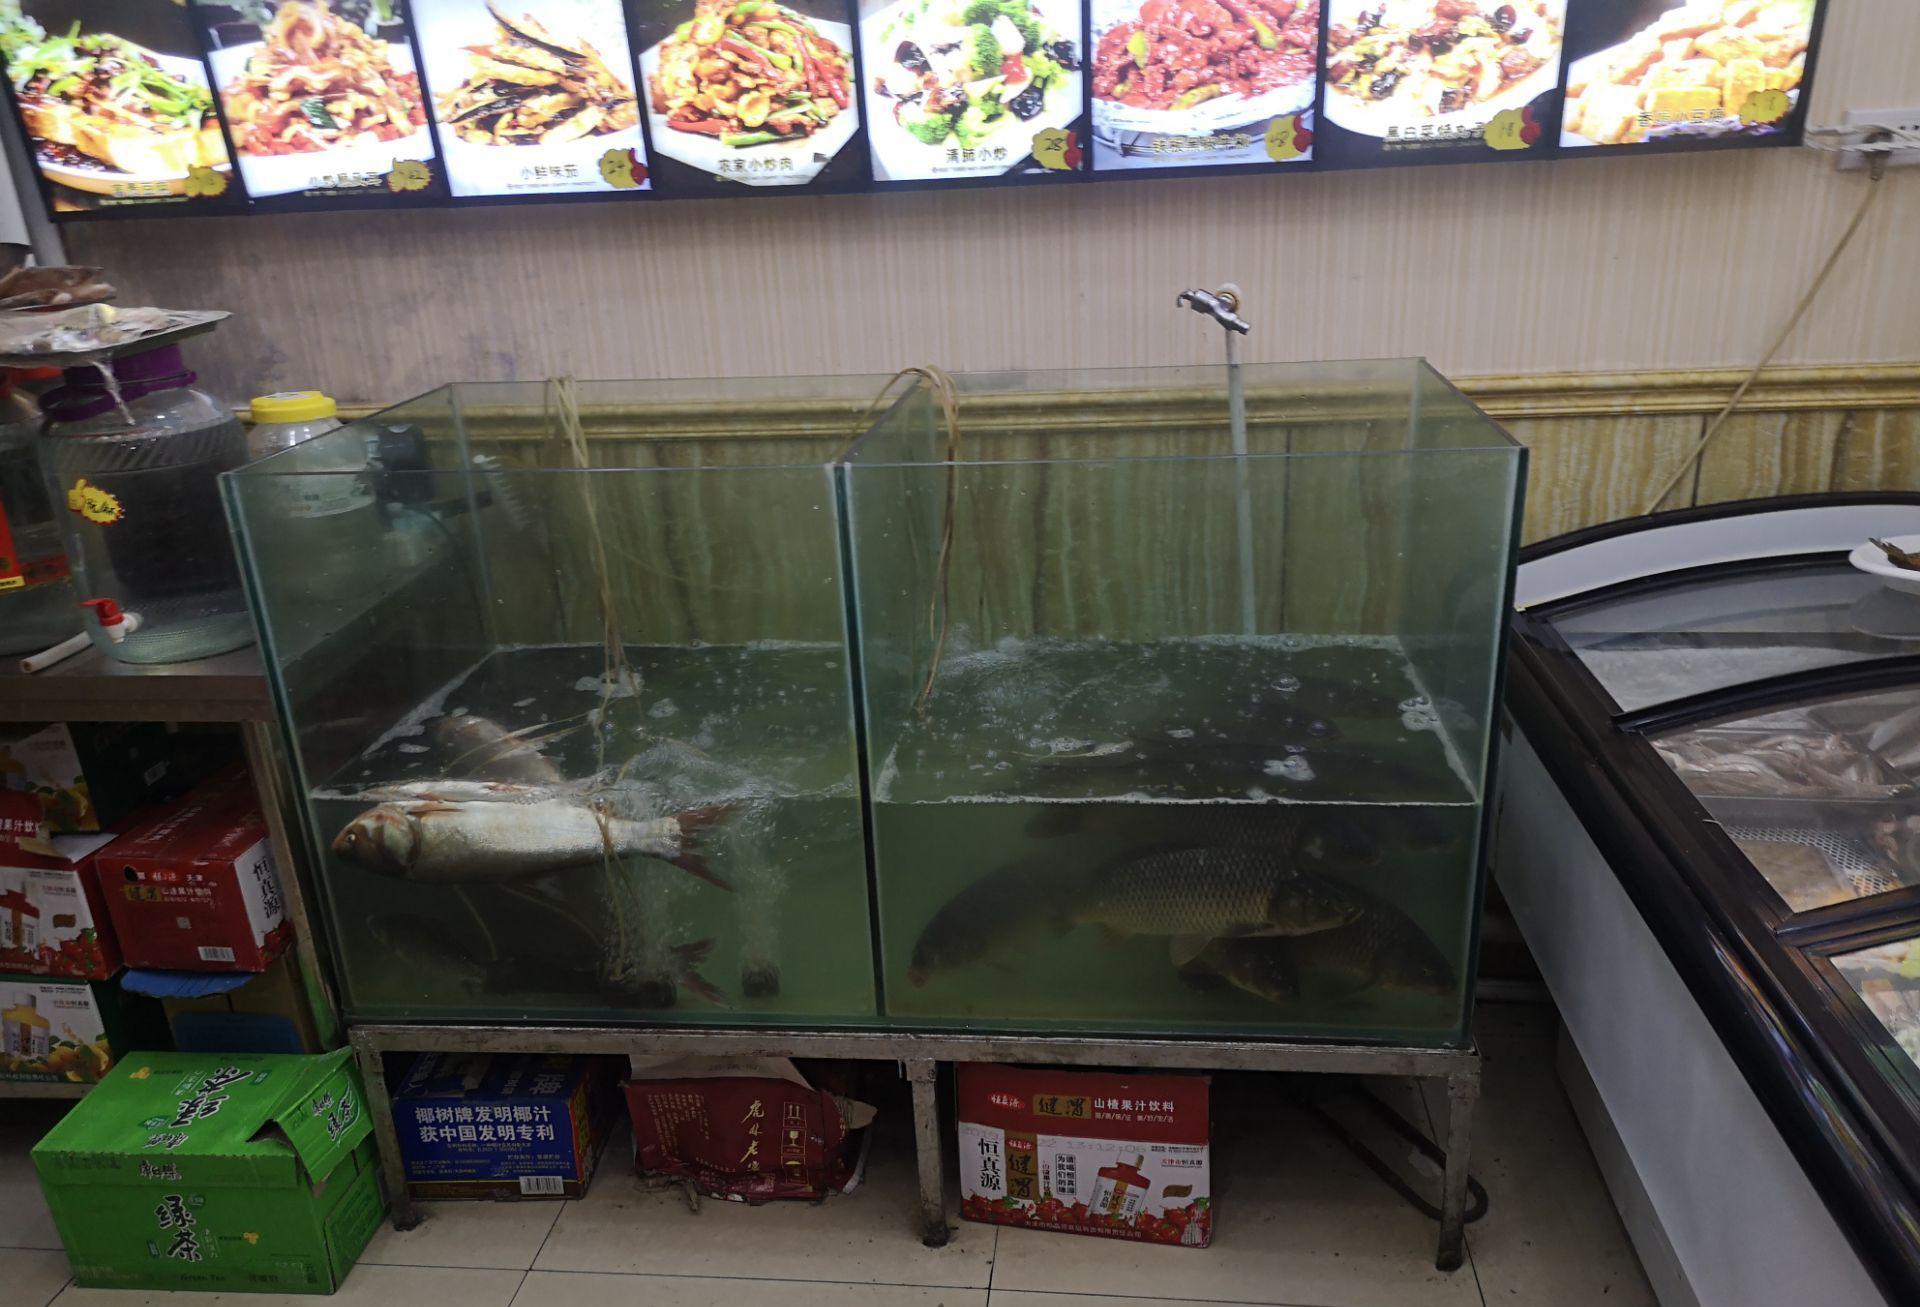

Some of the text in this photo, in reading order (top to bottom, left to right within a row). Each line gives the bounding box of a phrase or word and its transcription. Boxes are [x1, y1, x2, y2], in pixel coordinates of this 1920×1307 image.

[253, 857, 280, 918] 恒真源
[415, 1106, 551, 1124] 椰树牌发明椰汁
[1094, 1097, 1174, 1113] 山楂果汁饮料
[419, 1124, 555, 1143] 获中国发明专利
[978, 1137, 1001, 1191] 恒真源
[154, 1194, 203, 1262] 绿茶
